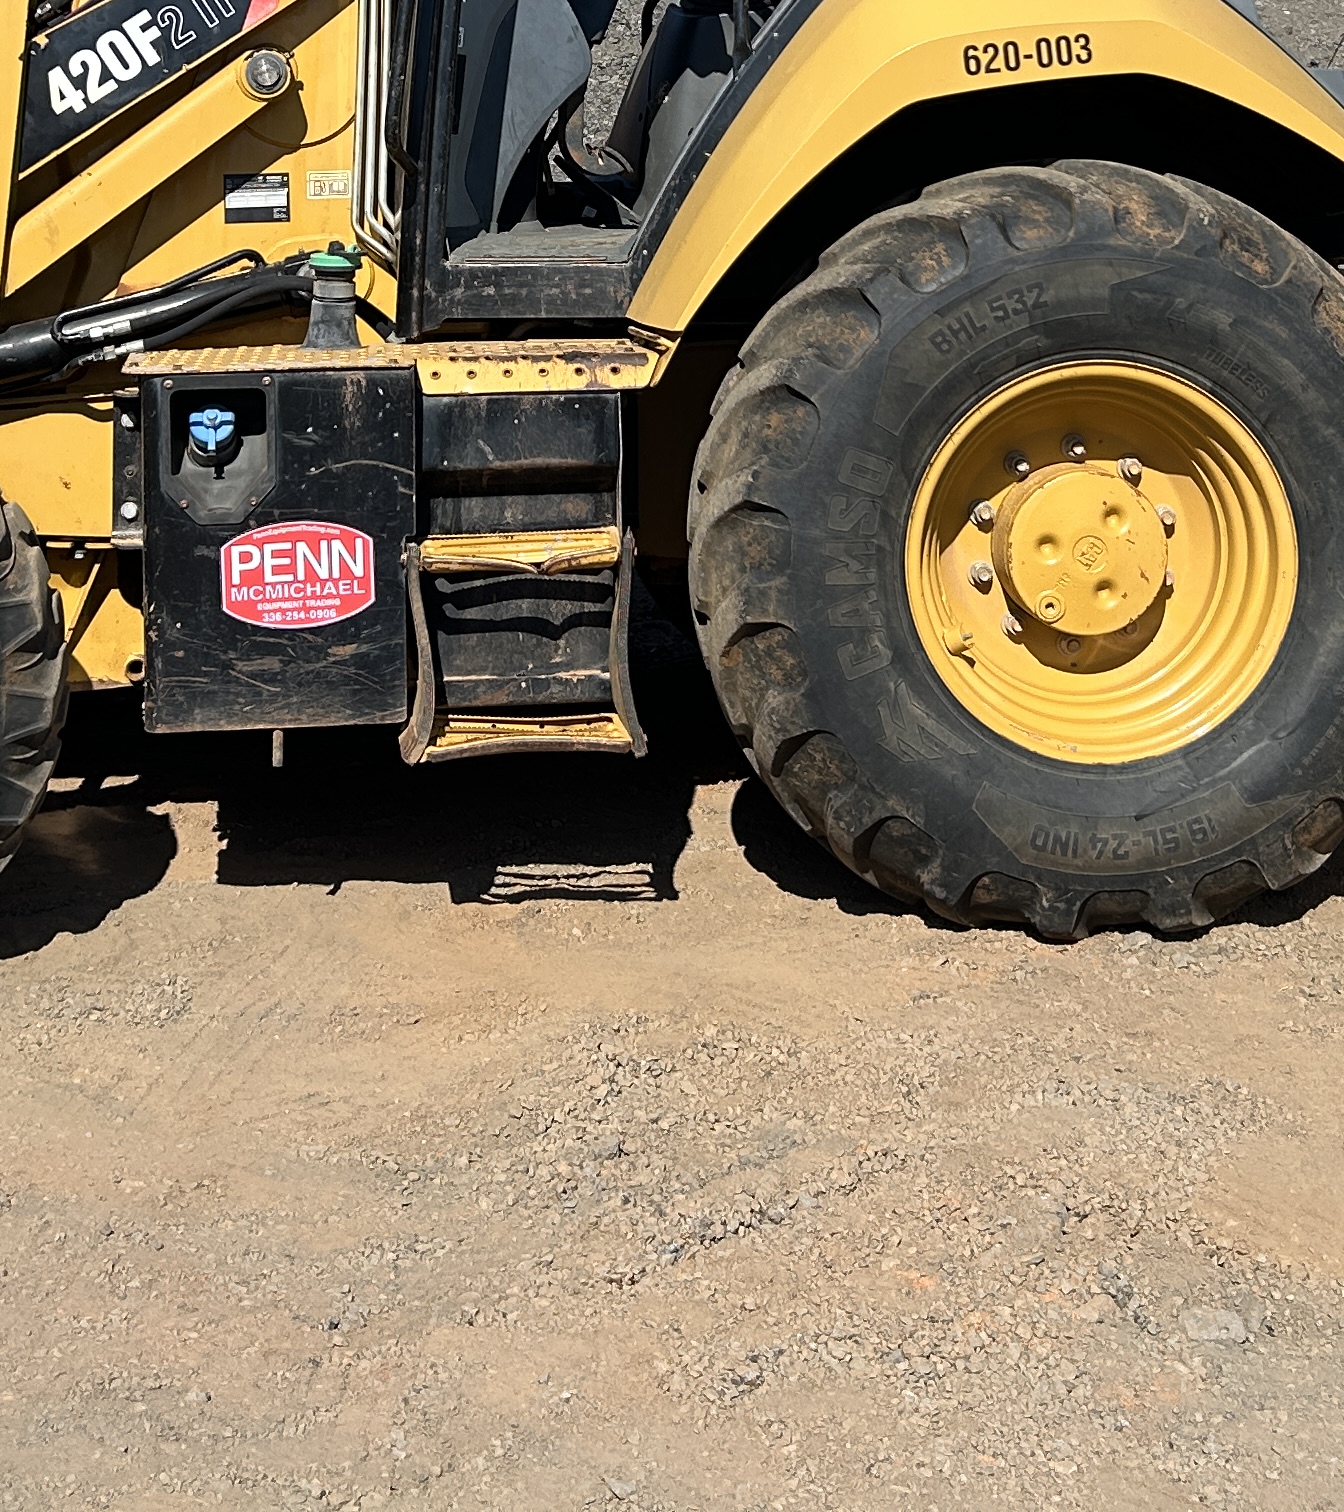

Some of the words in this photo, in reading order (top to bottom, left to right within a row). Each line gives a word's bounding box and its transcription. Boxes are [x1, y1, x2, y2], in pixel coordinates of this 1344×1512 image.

[963, 33, 1093, 76] 620-003
[928, 310, 987, 354] BHL
[985, 281, 1049, 321] 532
[230, 538, 365, 585] PENN
[824, 446, 894, 681] CAMSO
[230, 580, 366, 602] MCMICHAEL
[257, 600, 304, 611] EQUIPMENT
[305, 598, 341, 607] TRADING
[262, 609, 337, 622] 336-254-0906
[1028, 822, 1081, 859] IND
